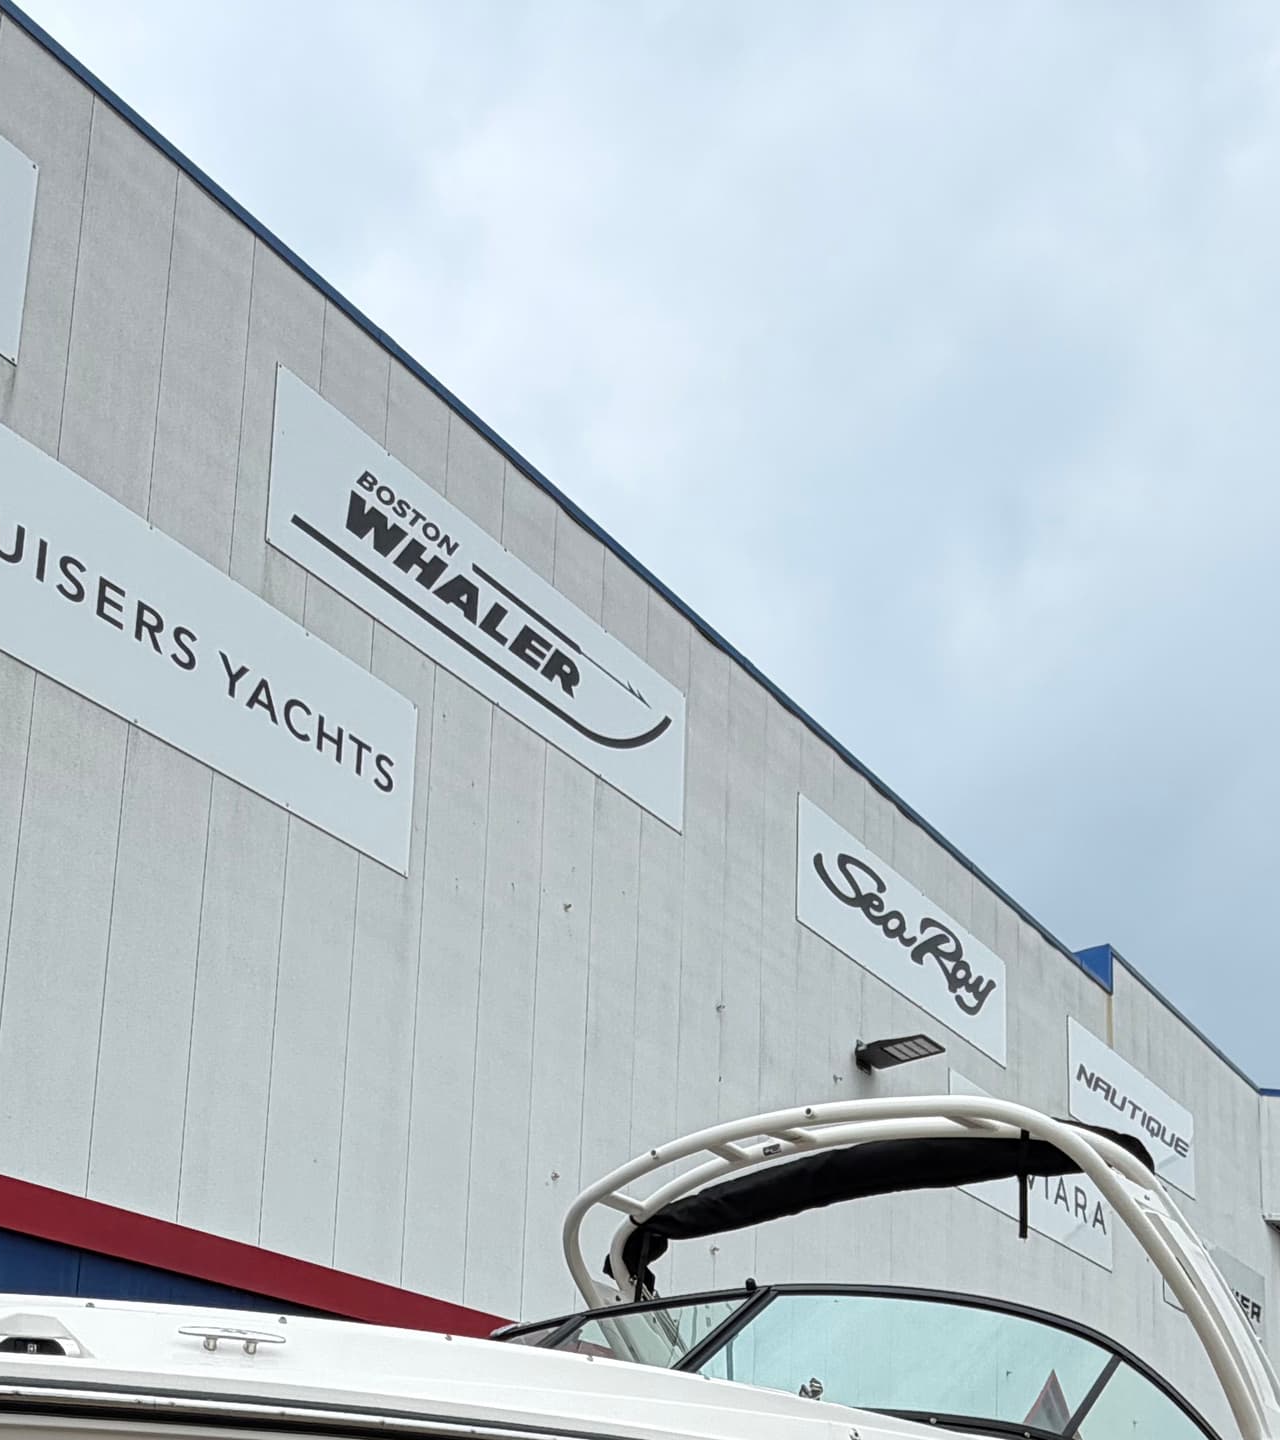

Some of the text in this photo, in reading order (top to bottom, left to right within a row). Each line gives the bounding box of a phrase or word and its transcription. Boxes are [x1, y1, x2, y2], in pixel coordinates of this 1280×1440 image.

[355, 470, 459, 556] BOSTON
[345, 490, 581, 699] WHALER
[218, 650, 395, 793] YACHTS
[1076, 1063, 1190, 1158] NAUTIQUE
